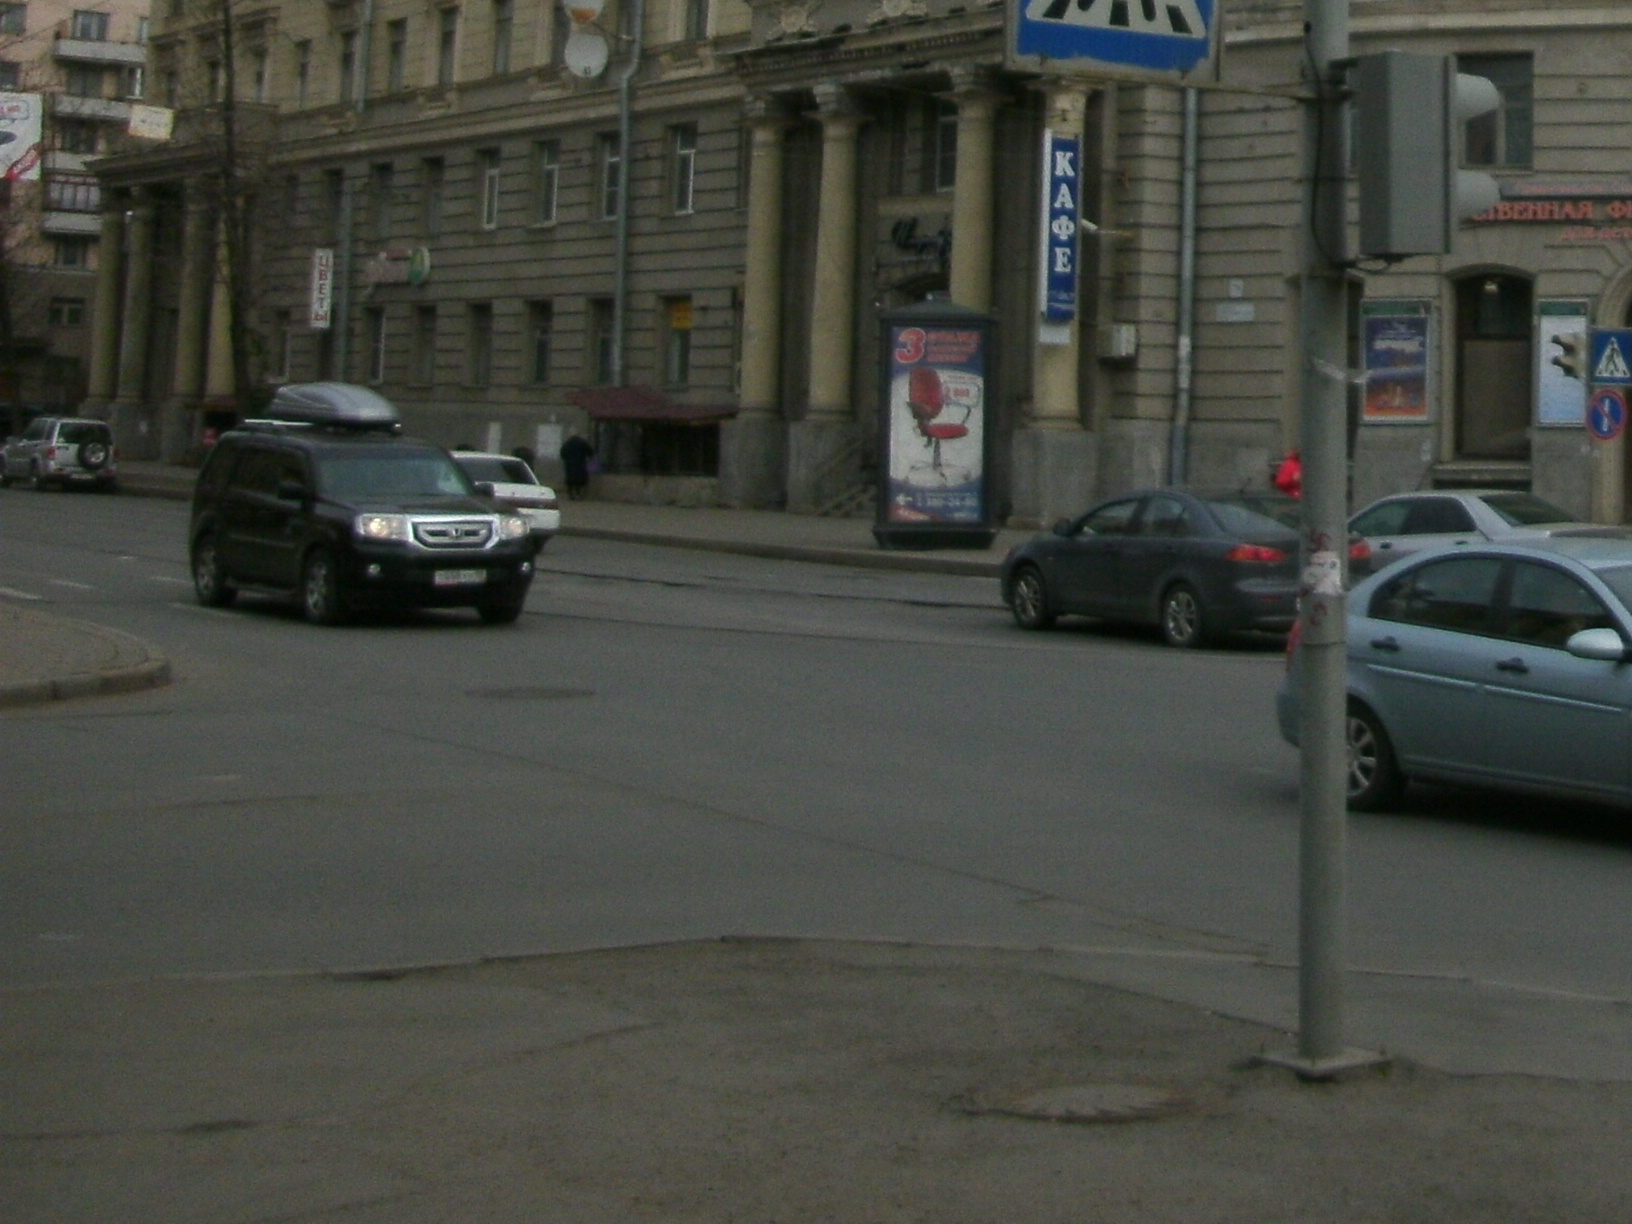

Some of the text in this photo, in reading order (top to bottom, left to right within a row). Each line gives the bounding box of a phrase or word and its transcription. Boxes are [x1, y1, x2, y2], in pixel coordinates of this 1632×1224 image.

[1051, 150, 1076, 273] КАФЕ
[314, 255, 330, 322] ЦВЕТЫ
[896, 328, 927, 364] 3
